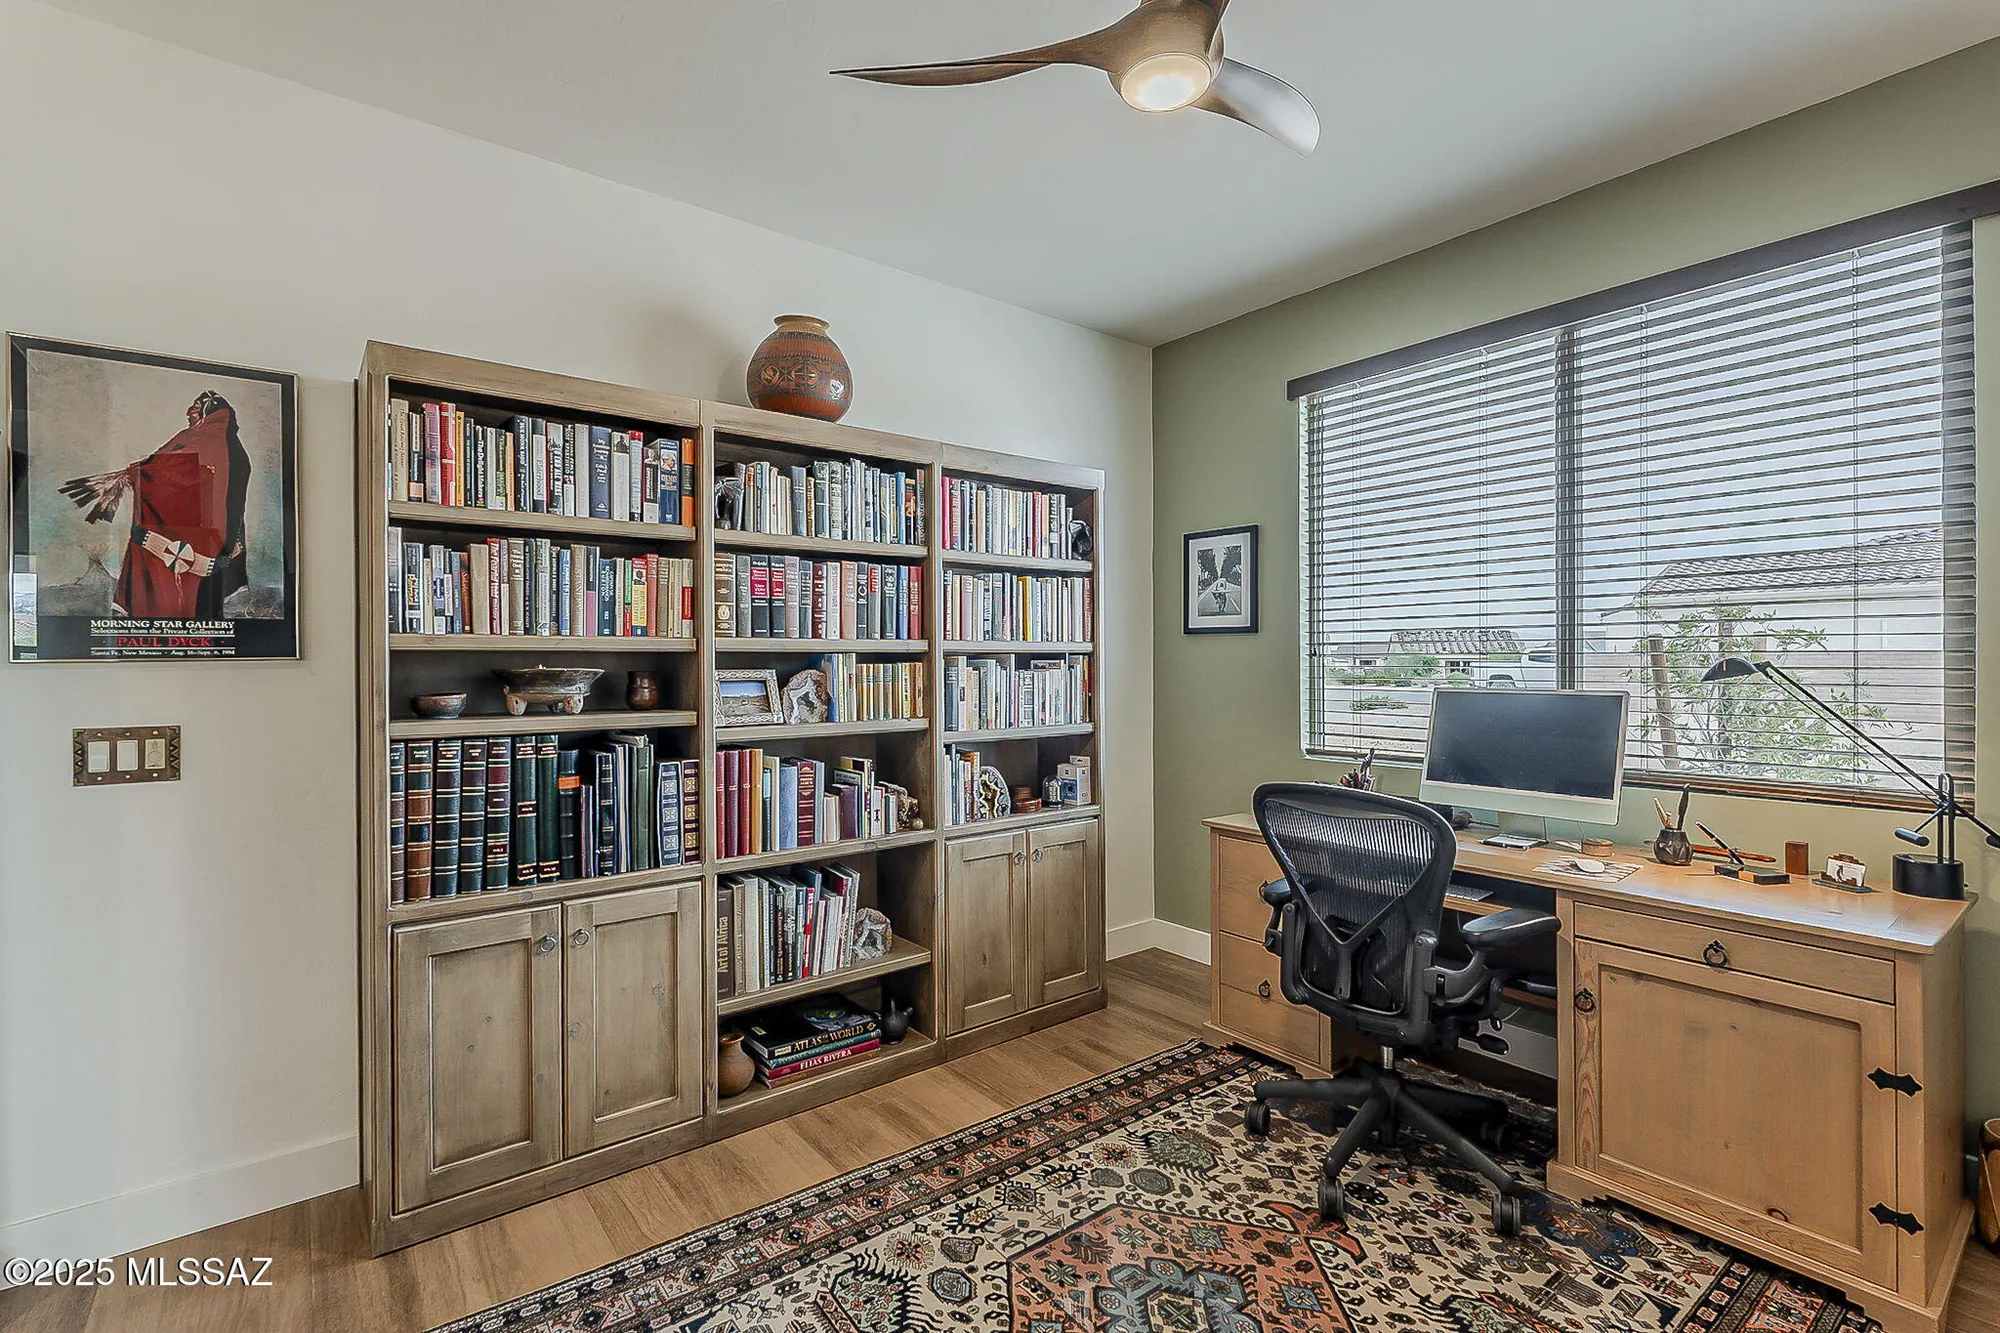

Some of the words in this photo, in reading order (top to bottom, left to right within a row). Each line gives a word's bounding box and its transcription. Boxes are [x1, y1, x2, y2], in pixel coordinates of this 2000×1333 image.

[116, 637, 163, 646] PAUL
[168, 637, 212, 646] DYCK
[717, 916, 728, 944] Africa
[717, 947, 728, 956] of
[717, 958, 728, 972] Art
[793, 1036, 822, 1052] ATLAS
[829, 1025, 864, 1041] WORLD
[800, 1055, 822, 1070] ELIAS
[824, 1049, 852, 1063] RIVERA
